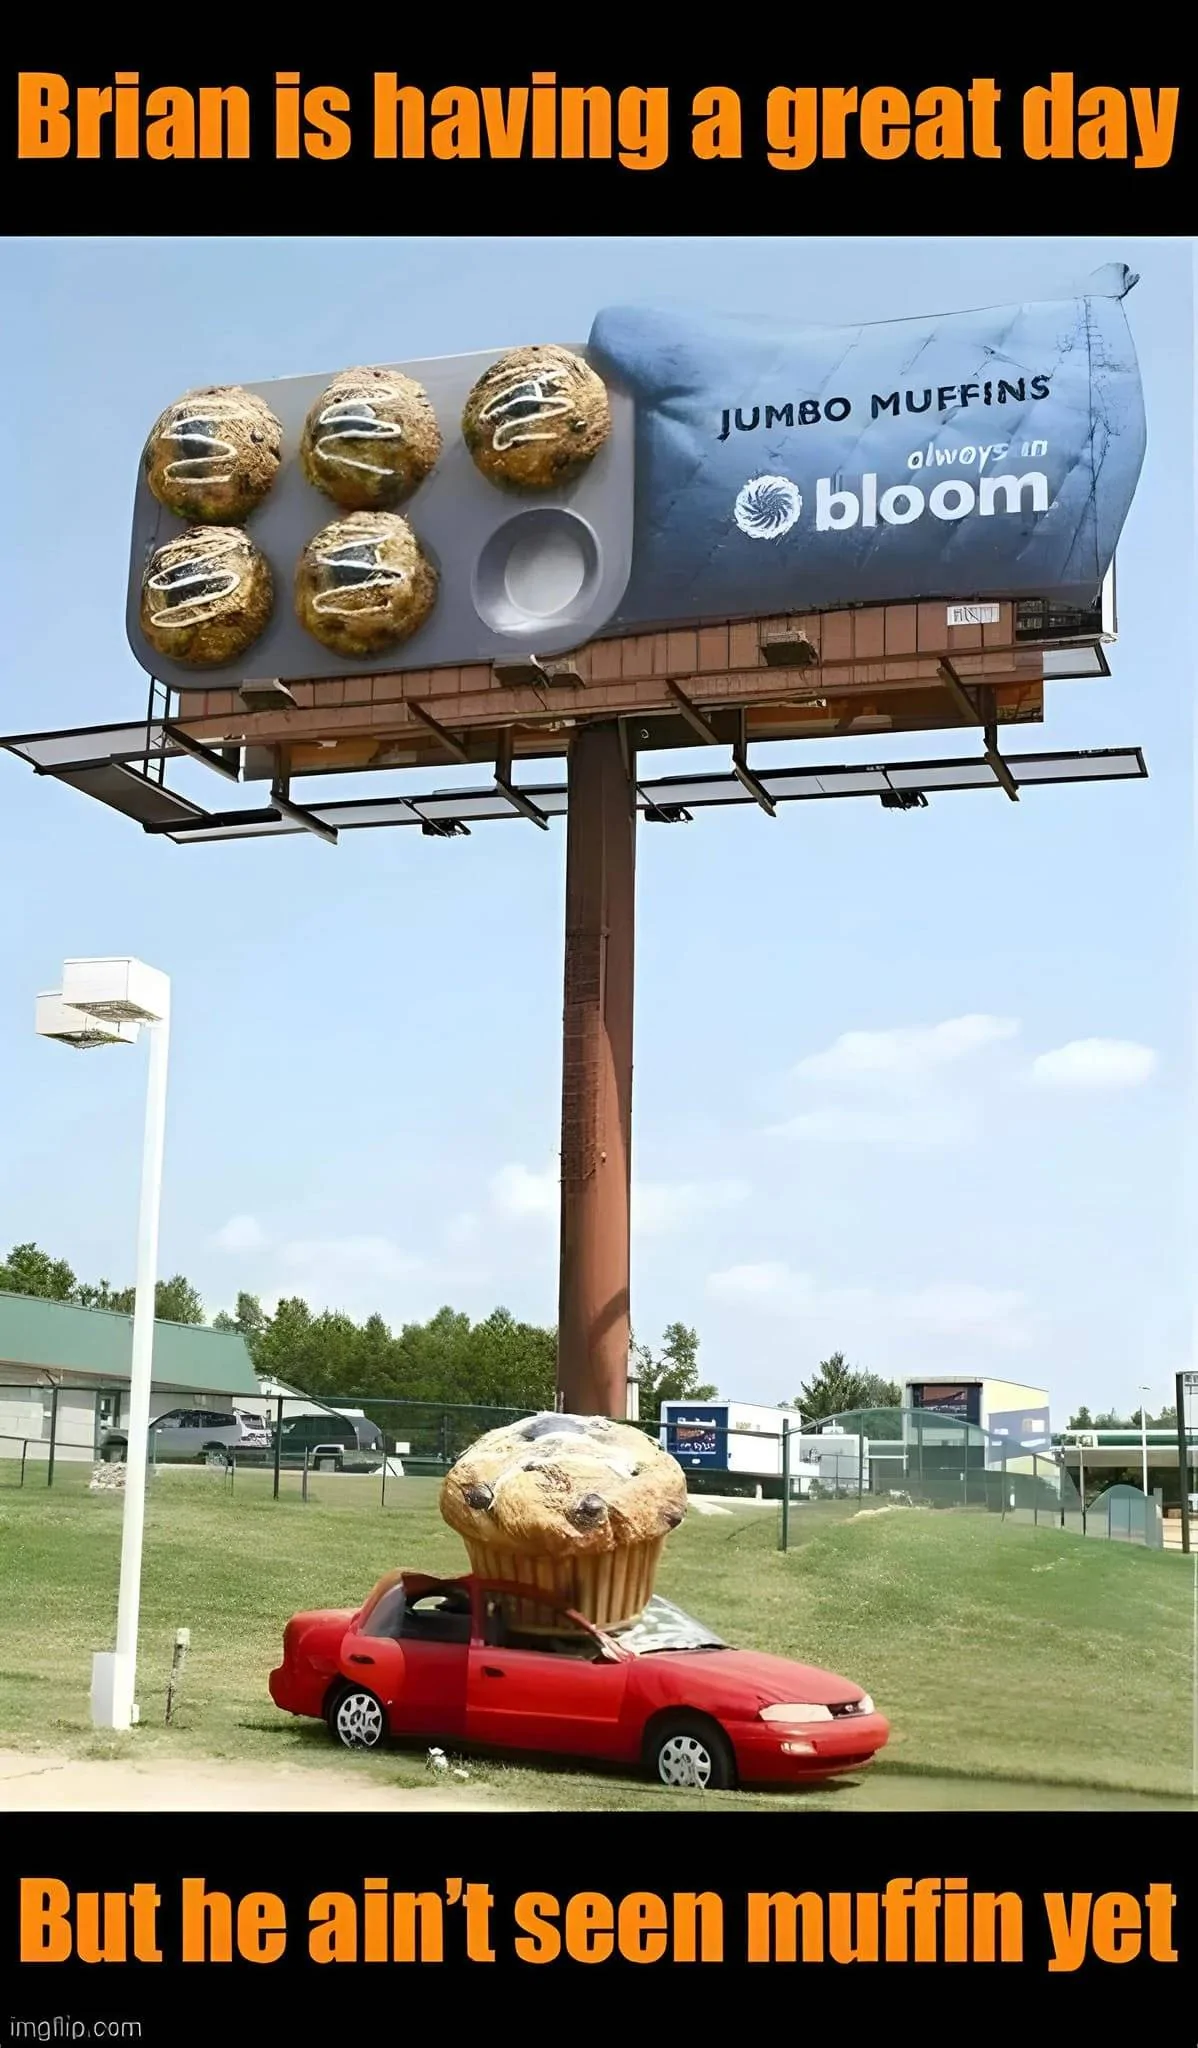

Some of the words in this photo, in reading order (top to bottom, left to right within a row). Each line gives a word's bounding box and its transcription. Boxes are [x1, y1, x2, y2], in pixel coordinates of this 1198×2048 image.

[716, 396, 852, 441] JUMBO
[870, 374, 1052, 420] MUFFINS
[907, 442, 1010, 473] always
[1020, 438, 1049, 459] in
[815, 470, 1051, 533] bloom
